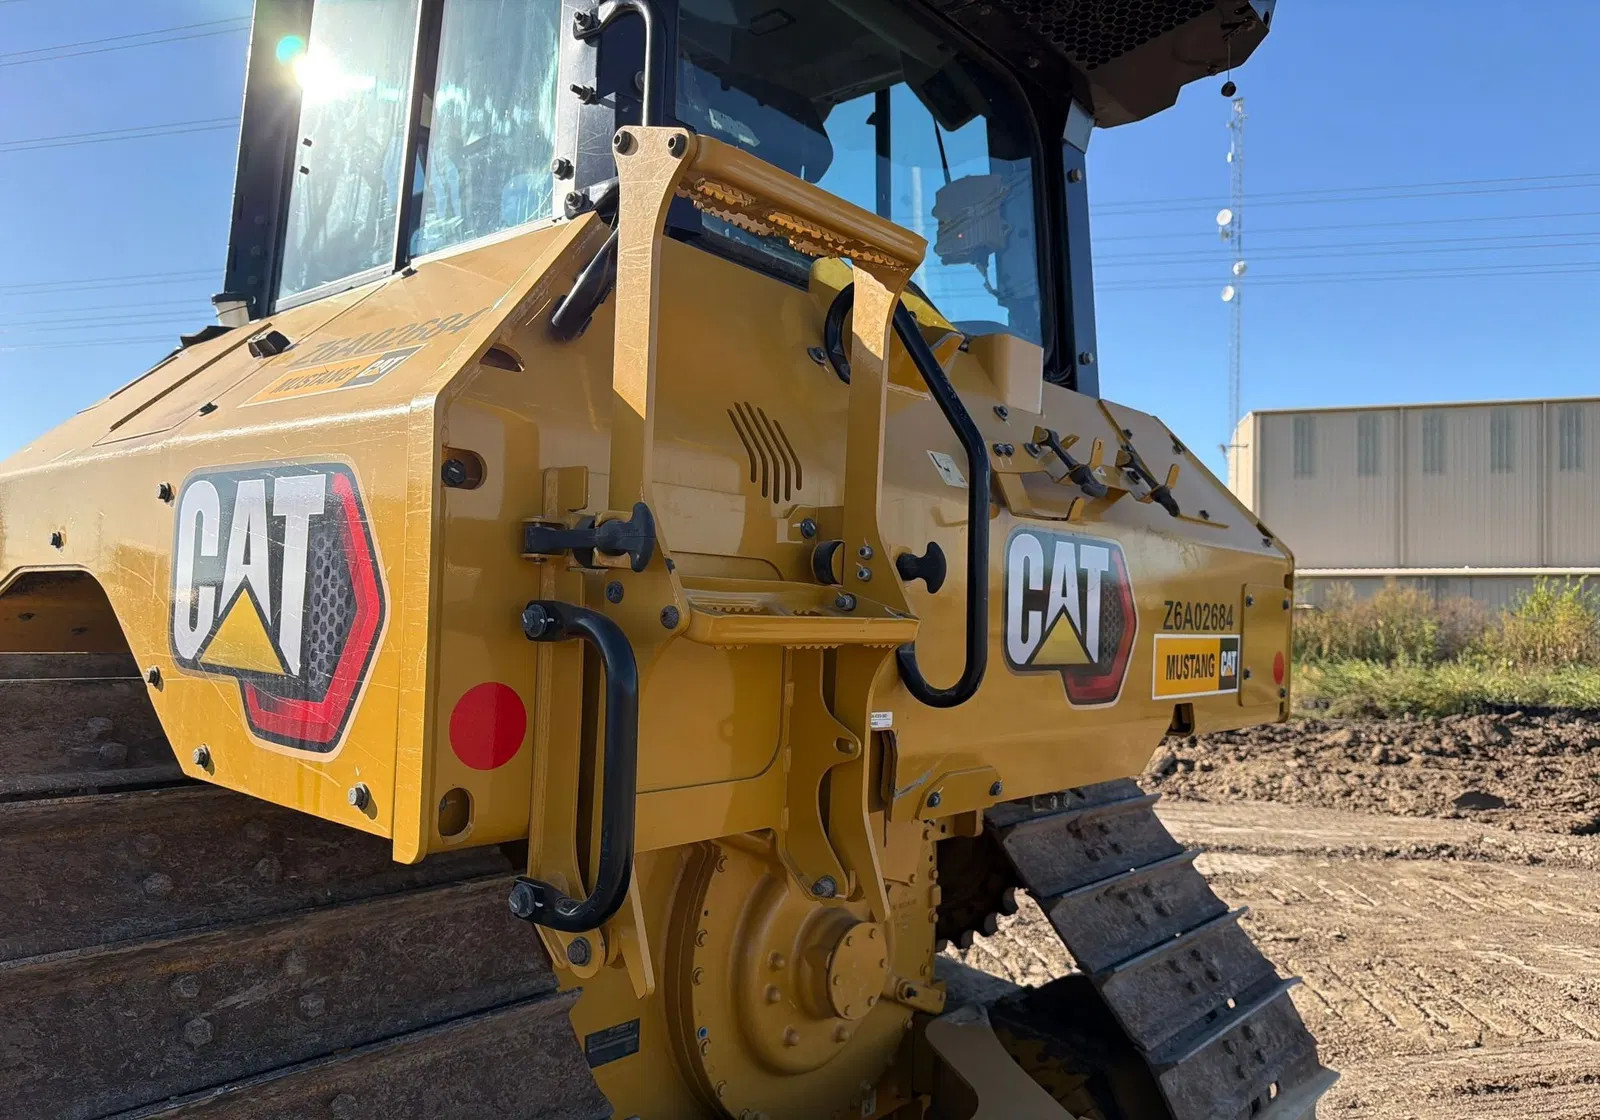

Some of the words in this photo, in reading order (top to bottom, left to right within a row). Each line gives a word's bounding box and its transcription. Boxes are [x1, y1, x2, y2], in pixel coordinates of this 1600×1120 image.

[285, 306, 492, 369] Z6A02684
[269, 365, 361, 394] MUSTANG
[173, 473, 327, 676] CAT
[1007, 533, 1109, 665] CAT
[1163, 600, 1234, 631] Z6A02684
[1165, 653, 1215, 680] MUSTANG
[1220, 650, 1238, 677] CAT
